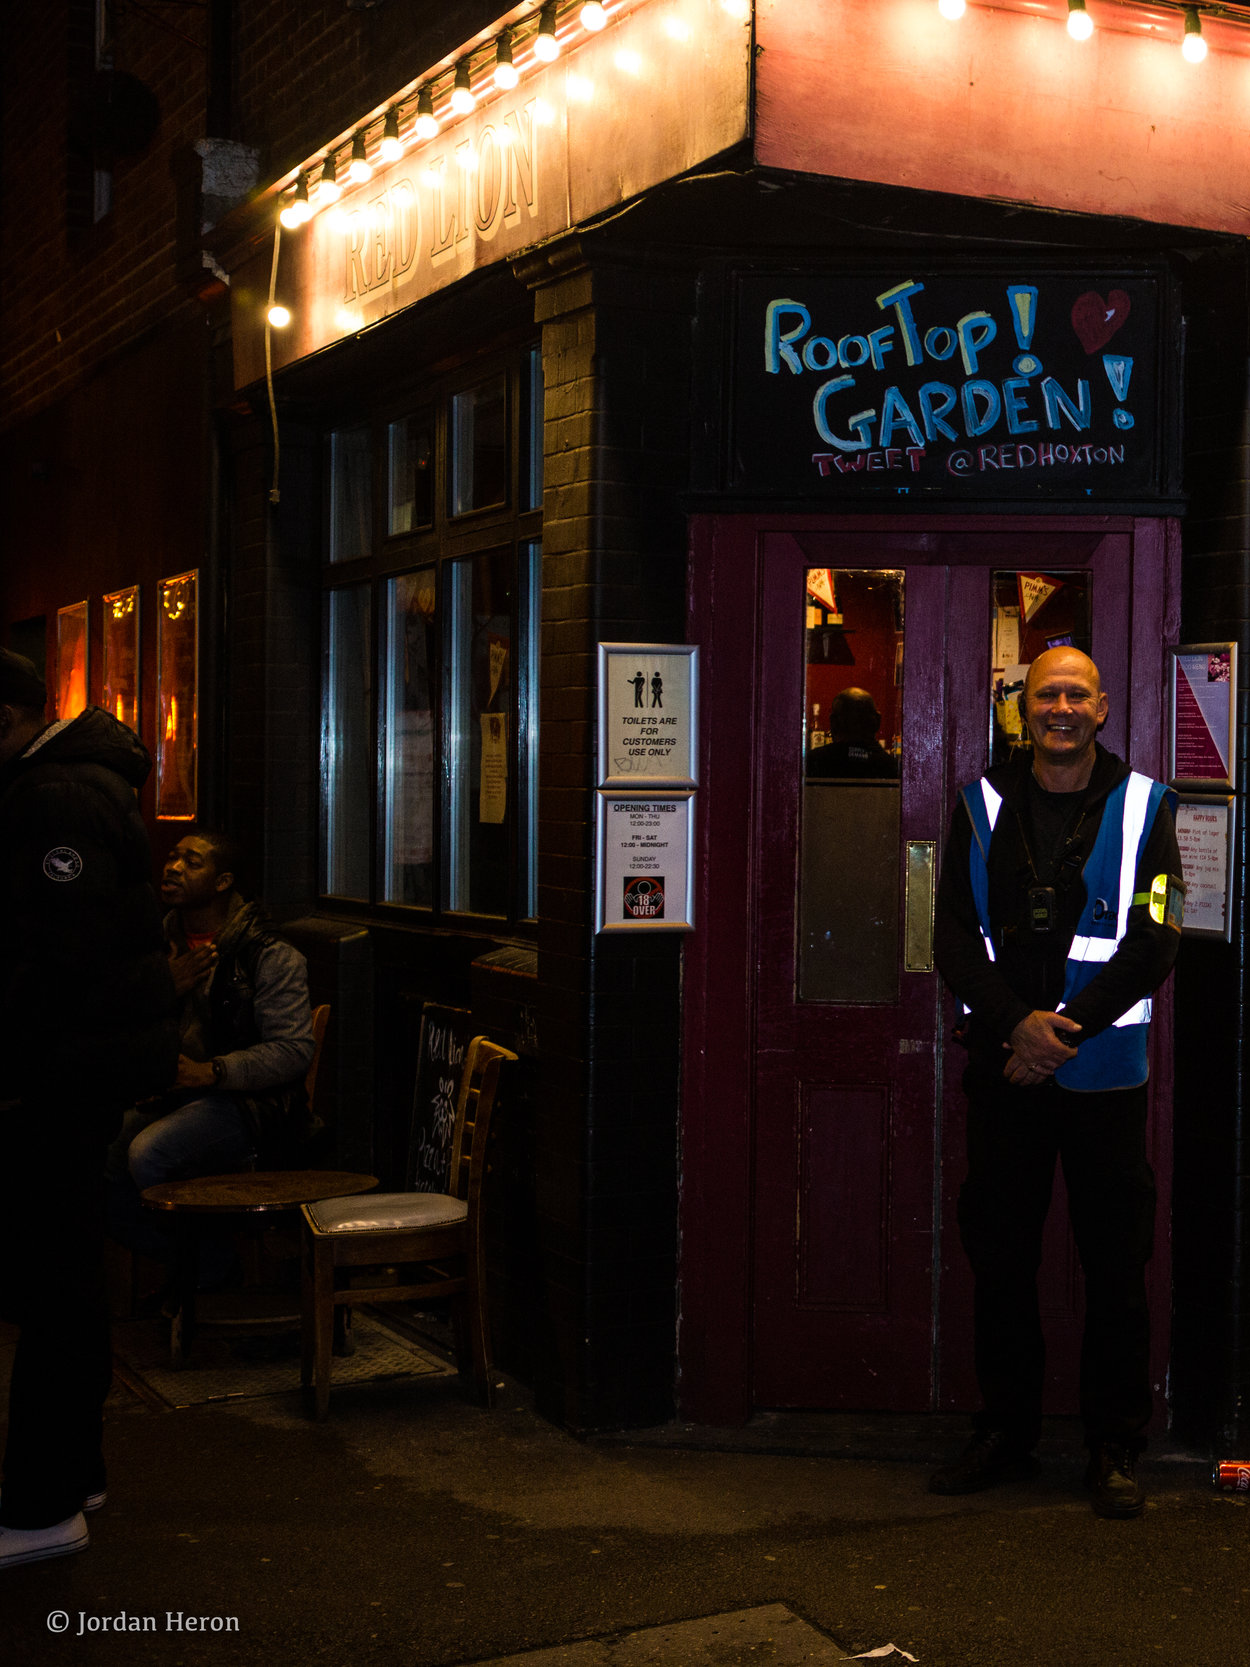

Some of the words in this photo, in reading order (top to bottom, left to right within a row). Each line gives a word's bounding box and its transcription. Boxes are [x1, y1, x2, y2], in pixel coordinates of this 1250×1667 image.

[430, 97, 540, 270] LION
[812, 446, 926, 477] TWEET
[1024, 581, 1049, 596] PIMM'S
[622, 717, 657, 725] TOILETS
[659, 717, 677, 725] ARE
[640, 727, 658, 735] FOR
[629, 748, 646, 756] USE
[648, 748, 671, 756] ONLY
[613, 804, 650, 812] OPENING
[652, 804, 677, 812] TIMES
[638, 894, 650, 906] 18
[632, 905, 657, 916] OVER
